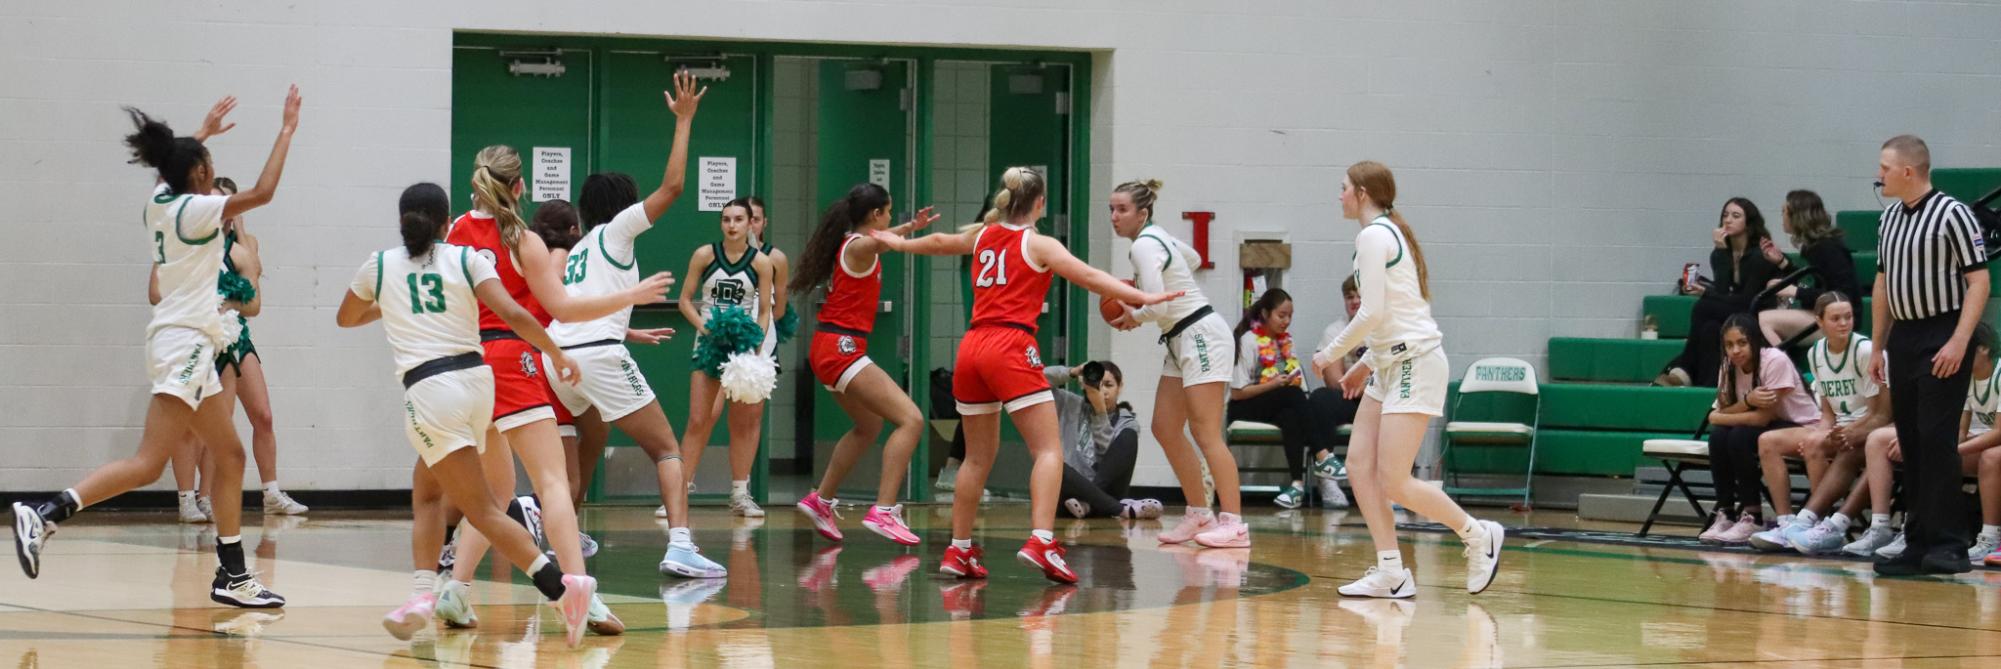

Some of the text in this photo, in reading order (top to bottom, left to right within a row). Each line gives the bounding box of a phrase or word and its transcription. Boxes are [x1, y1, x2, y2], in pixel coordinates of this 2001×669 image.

[976, 248, 1008, 288] 21
[406, 272, 448, 315] 13
[1399, 358, 1413, 399] PANTHER
[1475, 365, 1527, 382] PANTHERS
[1820, 378, 1857, 398] DERBY
